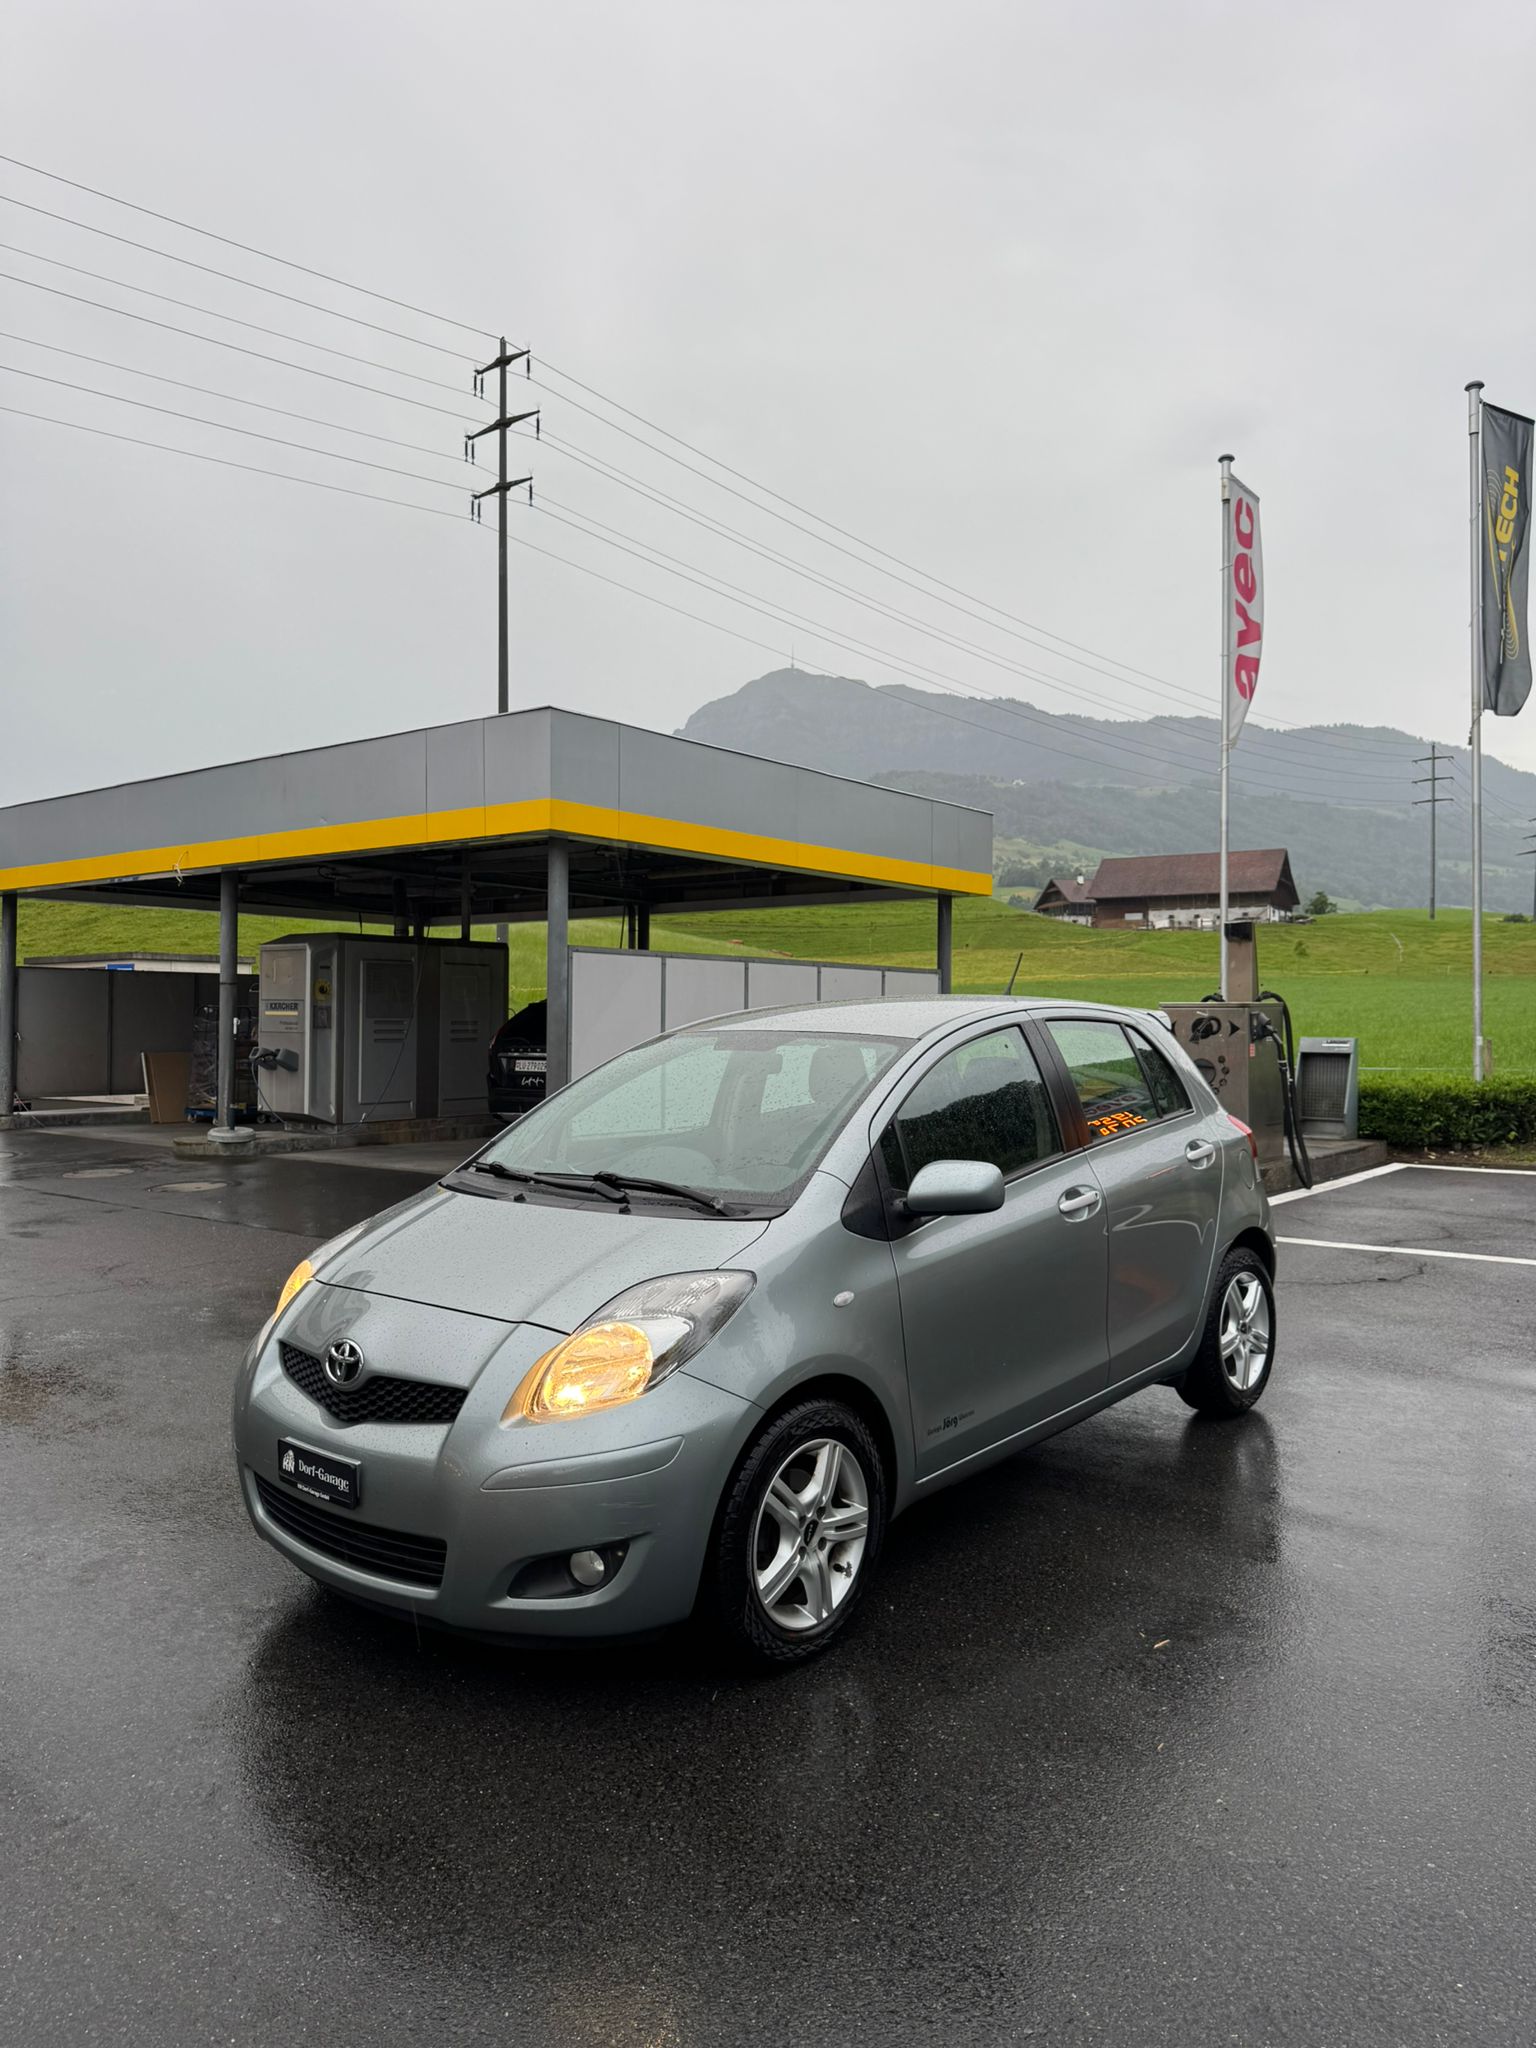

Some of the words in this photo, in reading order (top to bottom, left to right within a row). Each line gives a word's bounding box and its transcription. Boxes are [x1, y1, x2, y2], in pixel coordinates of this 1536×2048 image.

[1495, 465, 1520, 561] ECH
[1234, 496, 1262, 701] avec
[298, 1459, 350, 1492] Dorf-Garage
